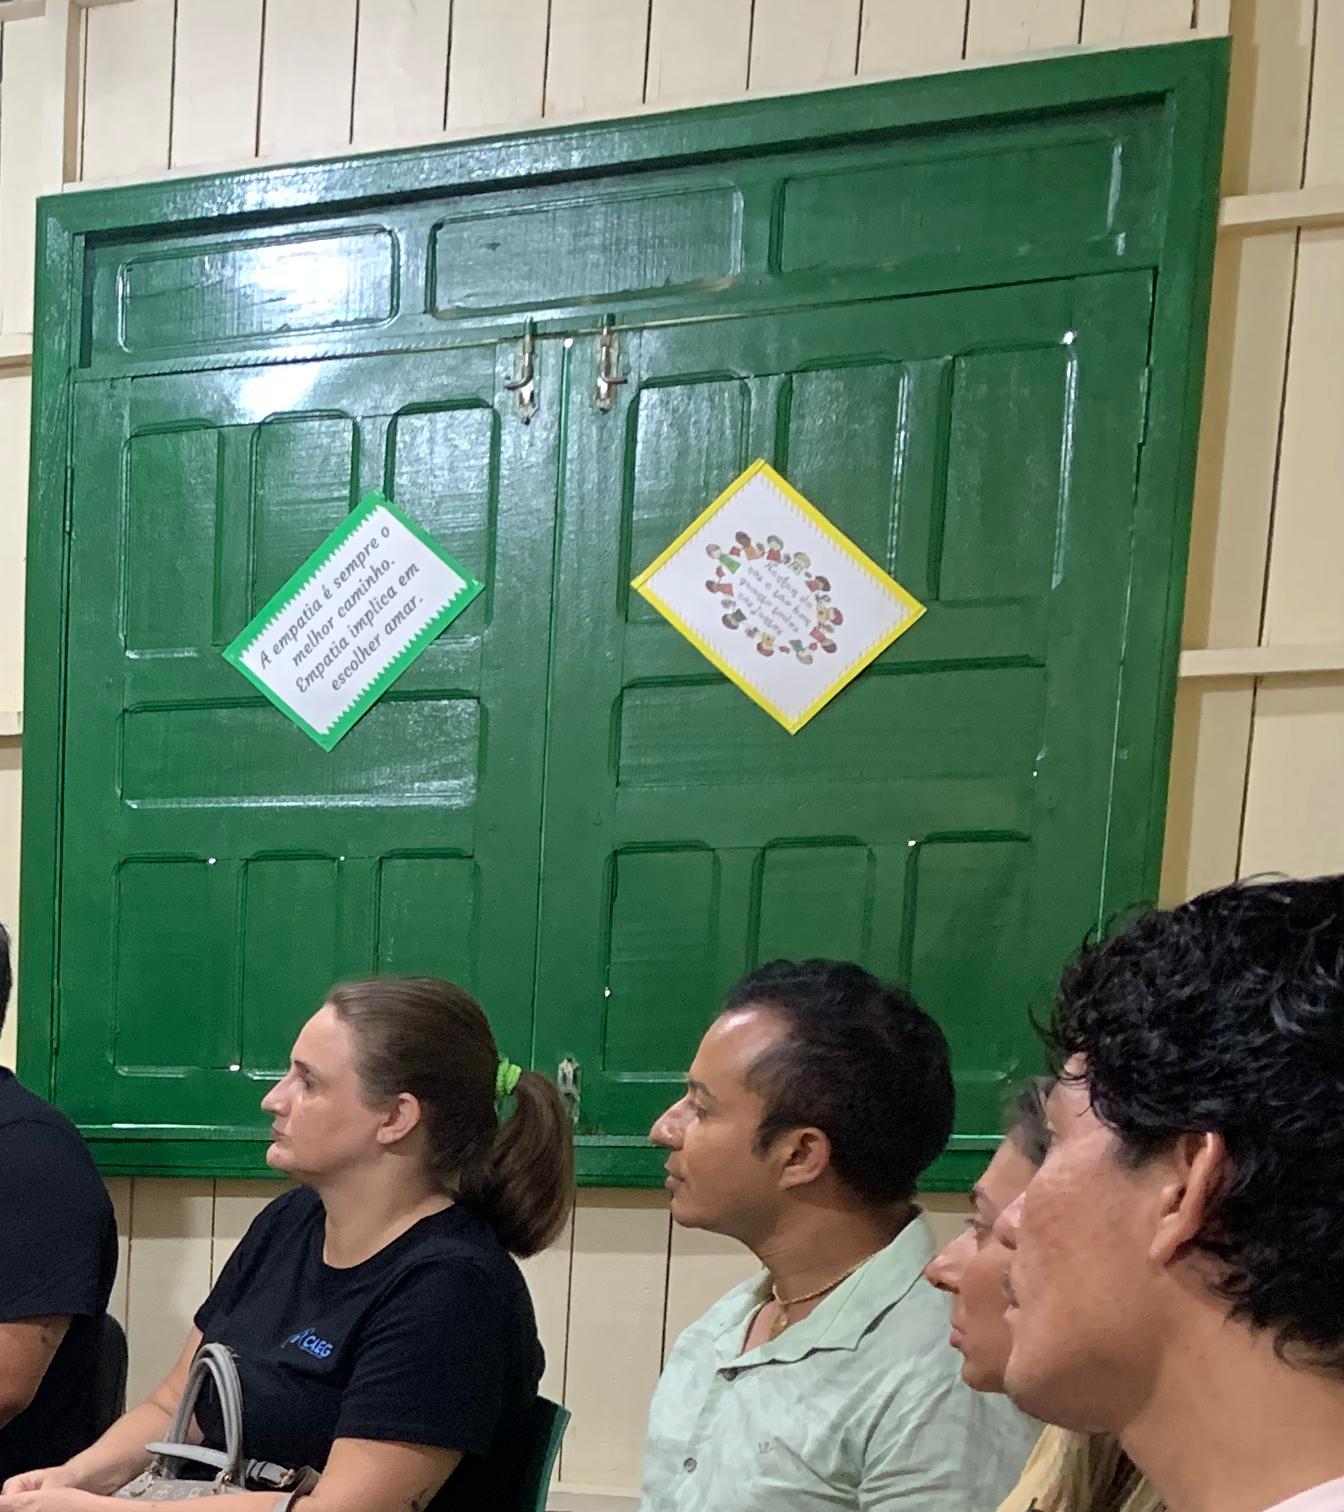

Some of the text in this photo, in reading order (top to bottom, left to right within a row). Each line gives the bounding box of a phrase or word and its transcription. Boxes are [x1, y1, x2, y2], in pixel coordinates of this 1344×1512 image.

[259, 525, 391, 670] A empatia é sempre o
[291, 559, 396, 668] melhor caminho.
[295, 561, 421, 693] Empatia implica em
[331, 596, 424, 691] escolher amar.
